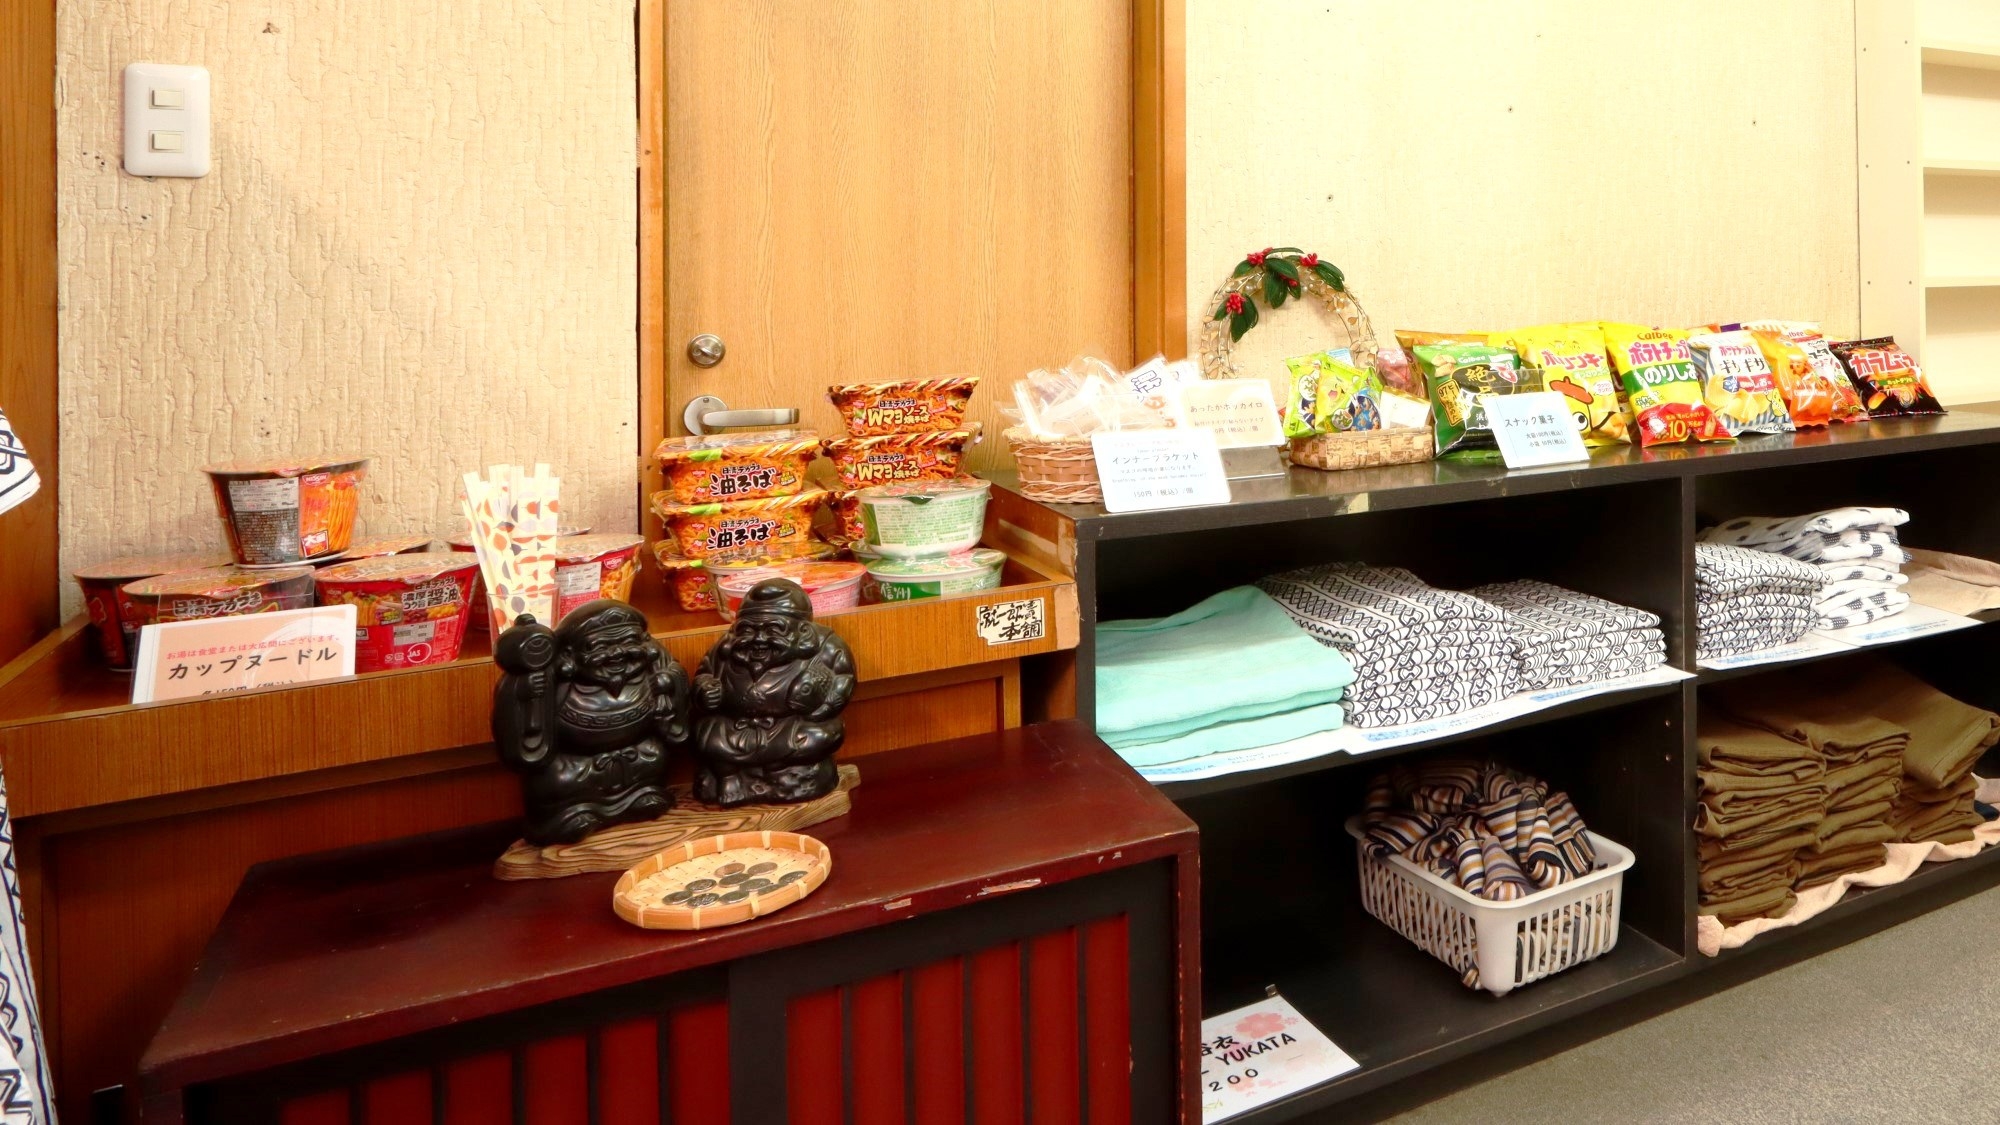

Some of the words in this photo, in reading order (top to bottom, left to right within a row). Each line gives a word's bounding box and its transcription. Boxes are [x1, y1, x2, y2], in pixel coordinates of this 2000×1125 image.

[1637, 331, 1674, 342] Calbee
[1190, 401, 1263, 413] あったかホッカイロ
[1504, 414, 1555, 428] スナック菓子
[710, 468, 775, 496] 油そば
[706, 521, 774, 549] 油そば
[168, 646, 338, 681] カップヌードル
[408, 649, 421, 658] JAS
[1215, 1032, 1297, 1066] YUKATA
